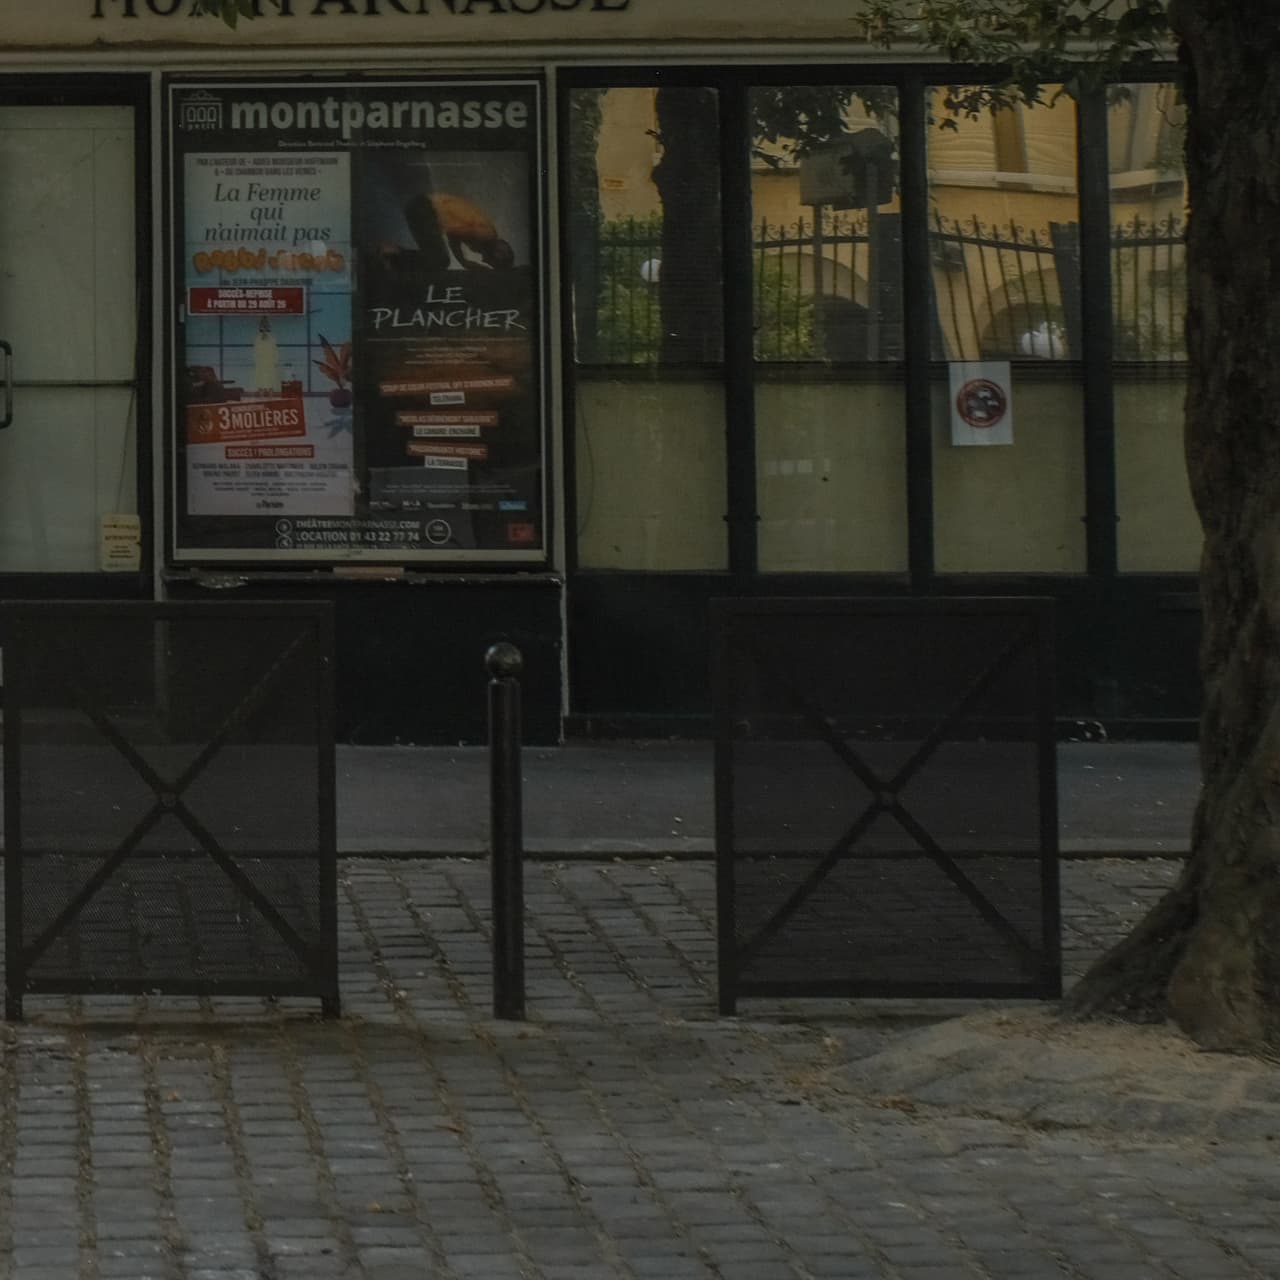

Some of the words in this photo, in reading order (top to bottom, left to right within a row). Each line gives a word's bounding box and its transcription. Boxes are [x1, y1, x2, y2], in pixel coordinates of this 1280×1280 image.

[231, 95, 528, 139] montparnasse
[215, 183, 240, 202] La
[247, 183, 321, 202] Femme
[249, 202, 283, 225] qui
[204, 222, 289, 242] n'aimait
[292, 227, 331, 246] pas
[424, 283, 468, 304] LE
[367, 306, 528, 331] PLANCHER
[218, 407, 231, 430] 3
[232, 407, 299, 429] MOLIÈRES
[296, 531, 348, 542] LOCATION
[378, 531, 391, 542] 22
